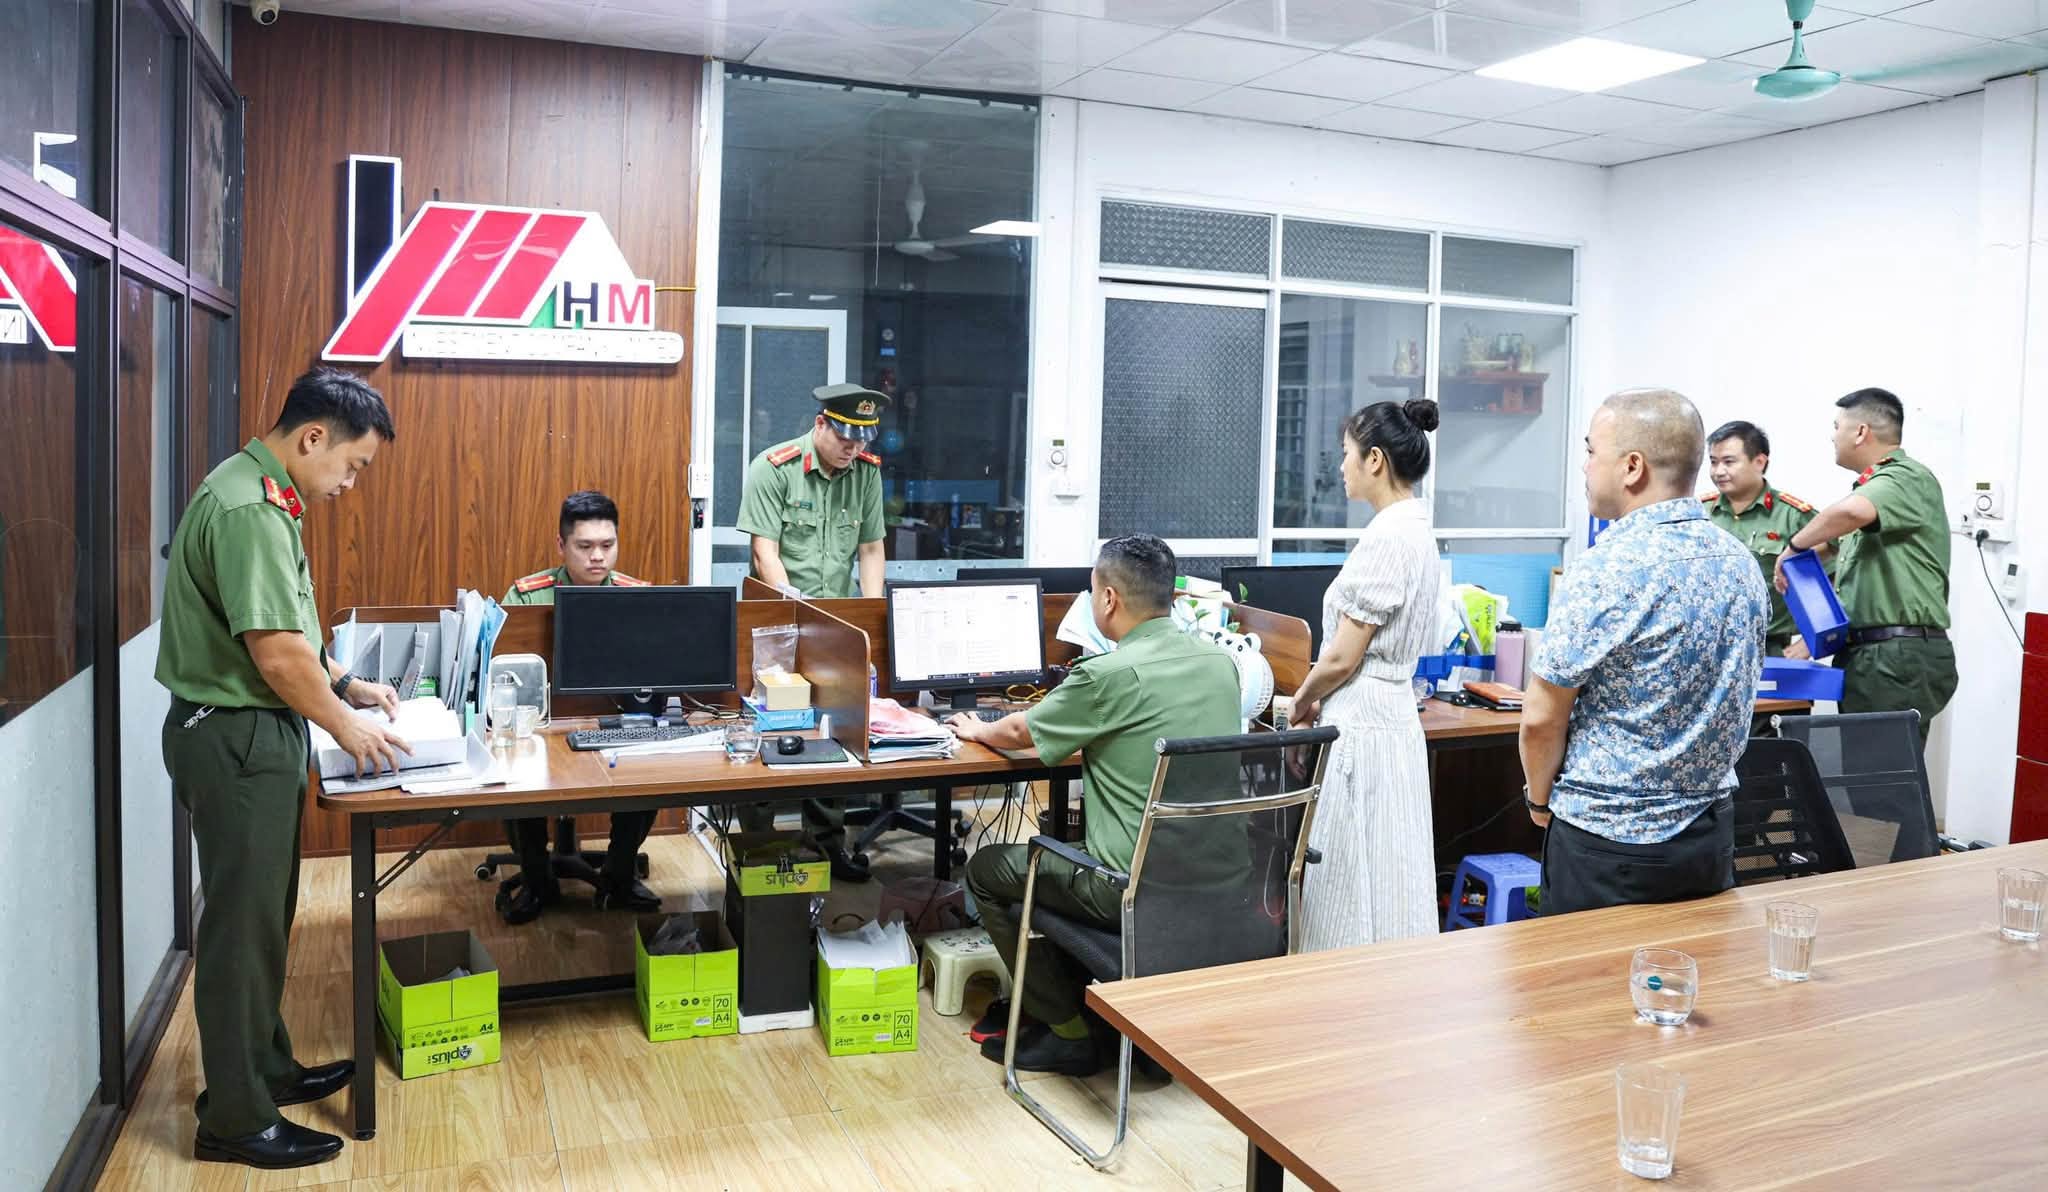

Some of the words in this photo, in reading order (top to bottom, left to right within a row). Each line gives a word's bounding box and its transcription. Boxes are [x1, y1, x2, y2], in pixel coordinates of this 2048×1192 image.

[563, 281, 651, 324] HM
[715, 998, 730, 1009] 70
[715, 1013, 730, 1024] A4
[896, 1014, 911, 1025] 70
[480, 1022, 494, 1032] A4
[895, 1030, 911, 1040] A4
[432, 1046, 460, 1064] plus
